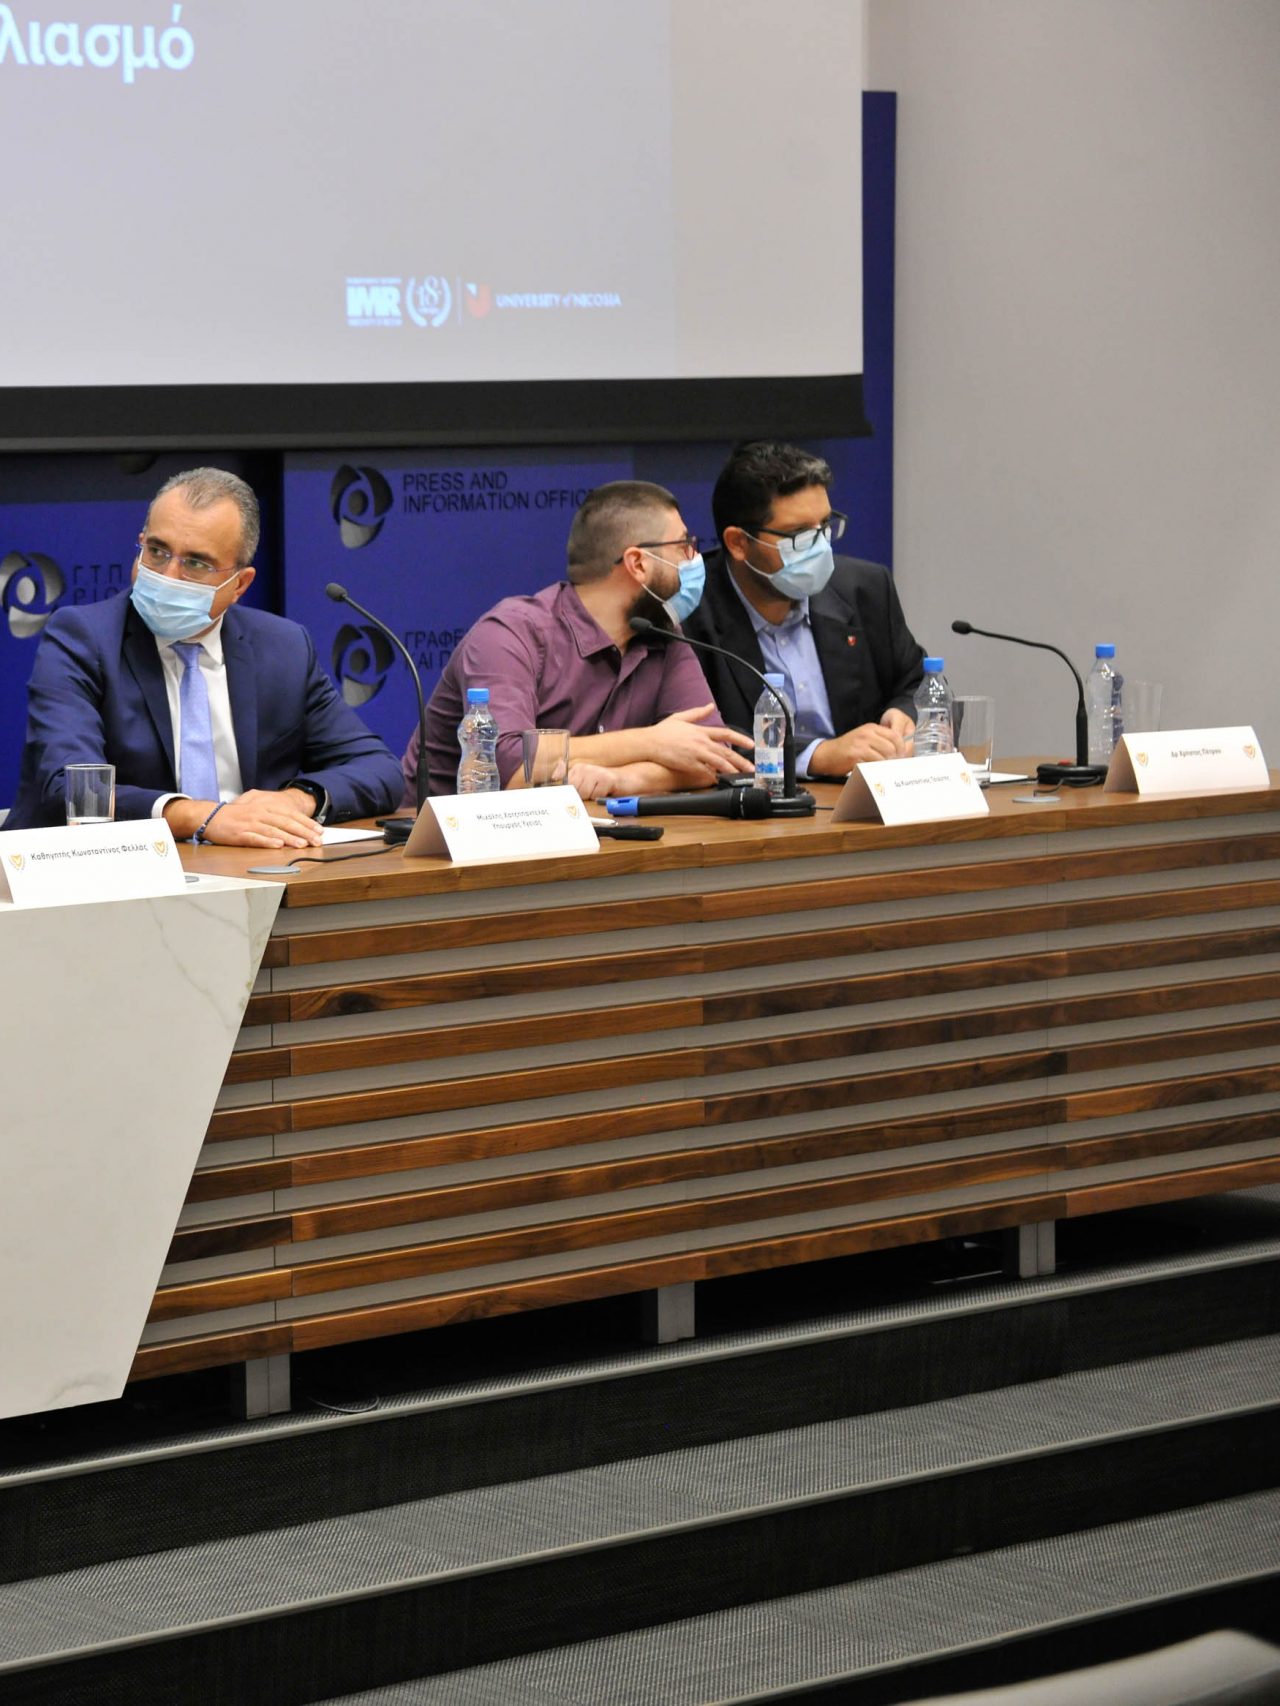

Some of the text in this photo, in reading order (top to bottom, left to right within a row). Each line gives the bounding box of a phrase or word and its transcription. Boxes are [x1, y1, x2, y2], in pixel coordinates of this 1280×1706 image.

[403, 470, 508, 493] PRESS AND
[403, 487, 590, 514] INFORMATION OFFIC
